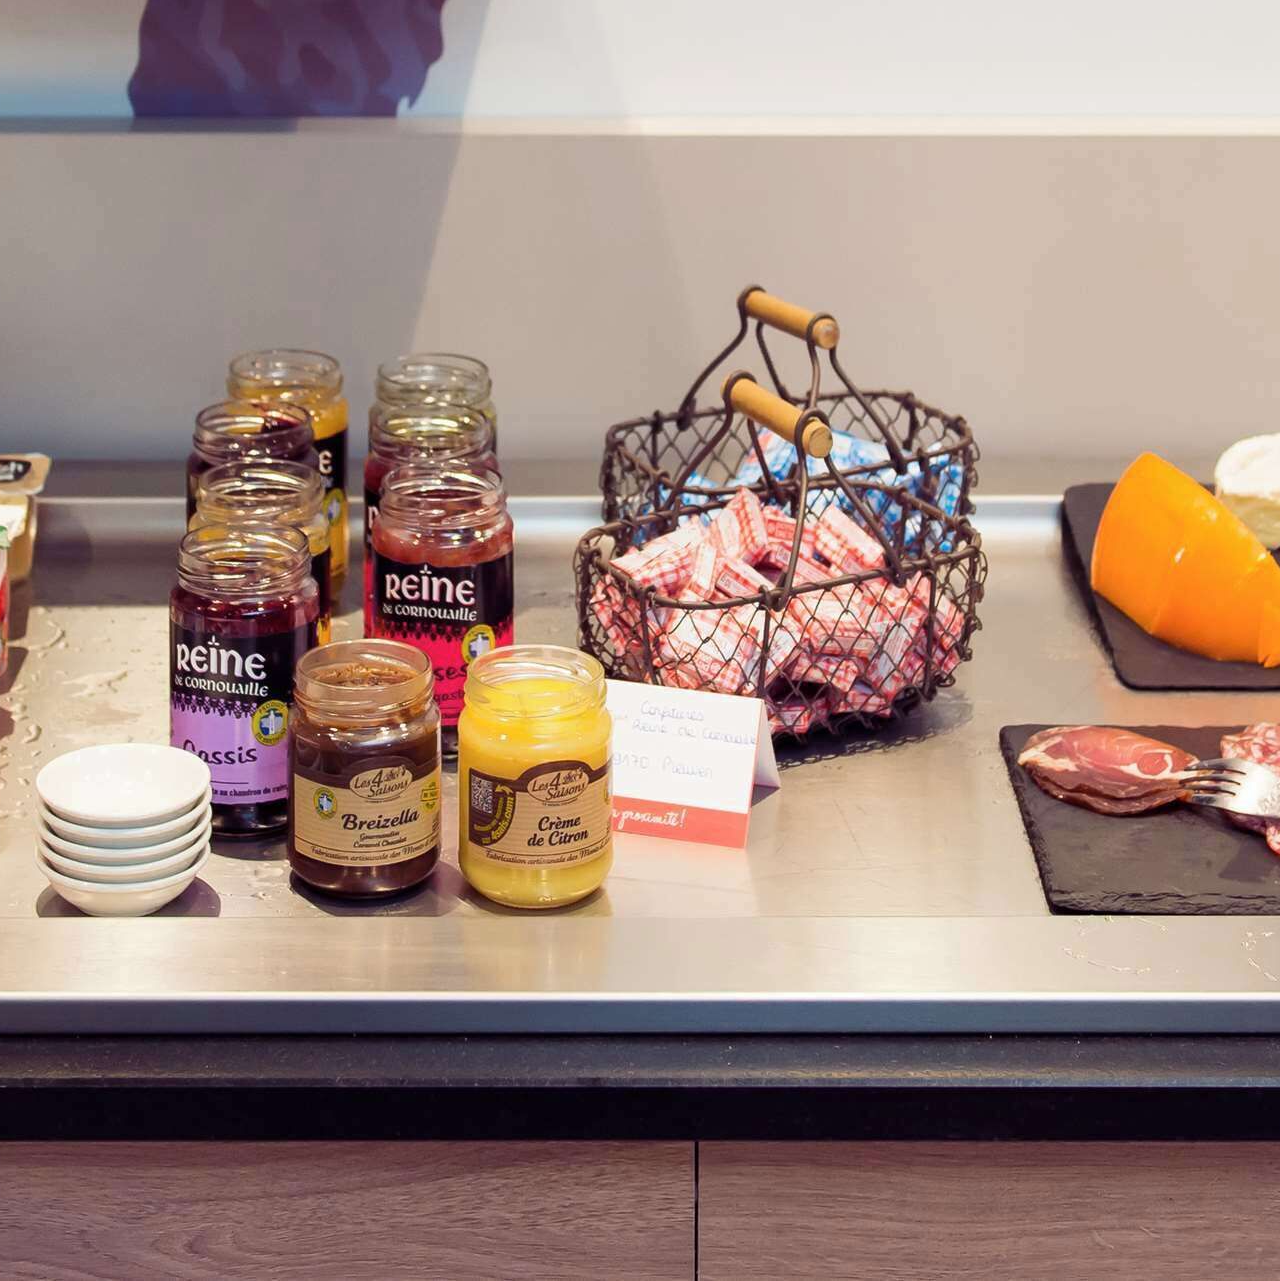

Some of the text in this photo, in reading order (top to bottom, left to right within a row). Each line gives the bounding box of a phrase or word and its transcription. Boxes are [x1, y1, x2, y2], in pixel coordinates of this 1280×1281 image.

[353, 770, 384, 790] Les 4
[532, 772, 561, 792] Les 4
[367, 781, 409, 798] Saisons
[545, 783, 586, 801] Saisons
[341, 807, 420, 831] Breizella
[538, 814, 582, 832] Crème
[527, 829, 589, 847] de Citron
